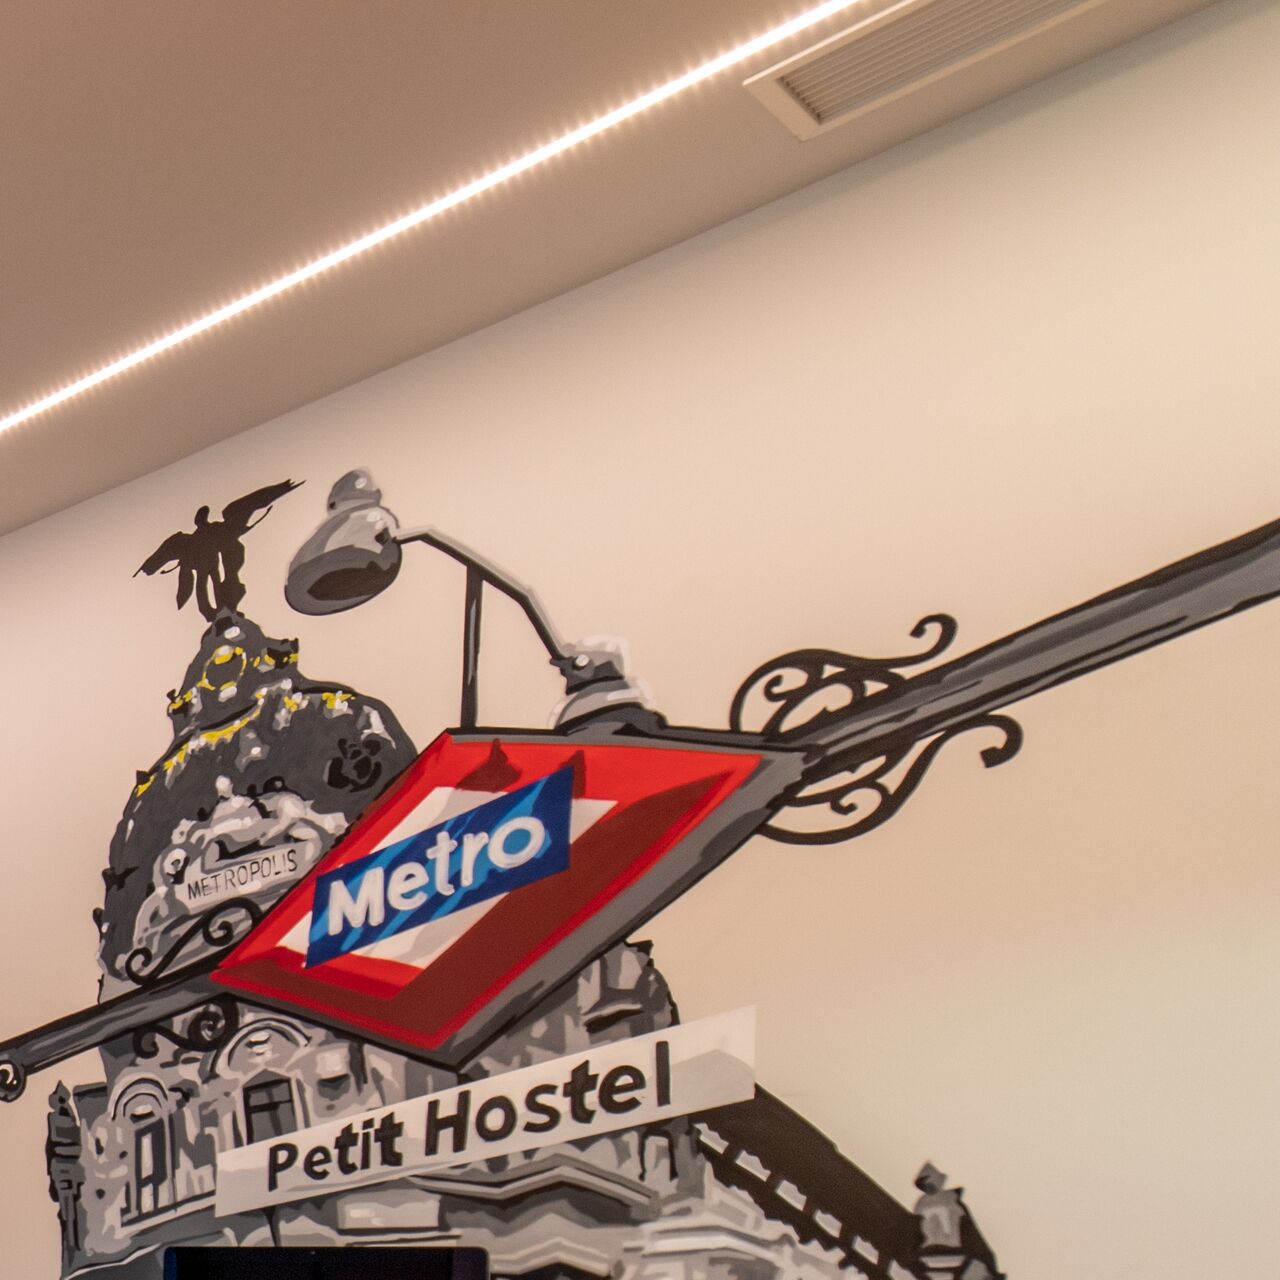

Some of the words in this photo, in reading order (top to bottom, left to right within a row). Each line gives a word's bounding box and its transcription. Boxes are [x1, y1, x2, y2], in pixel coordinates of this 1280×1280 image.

[187, 849, 298, 900] METROPOLIS
[327, 816, 546, 936] Metro
[268, 1112, 404, 1193] Petit
[425, 1040, 672, 1157] Hostel
